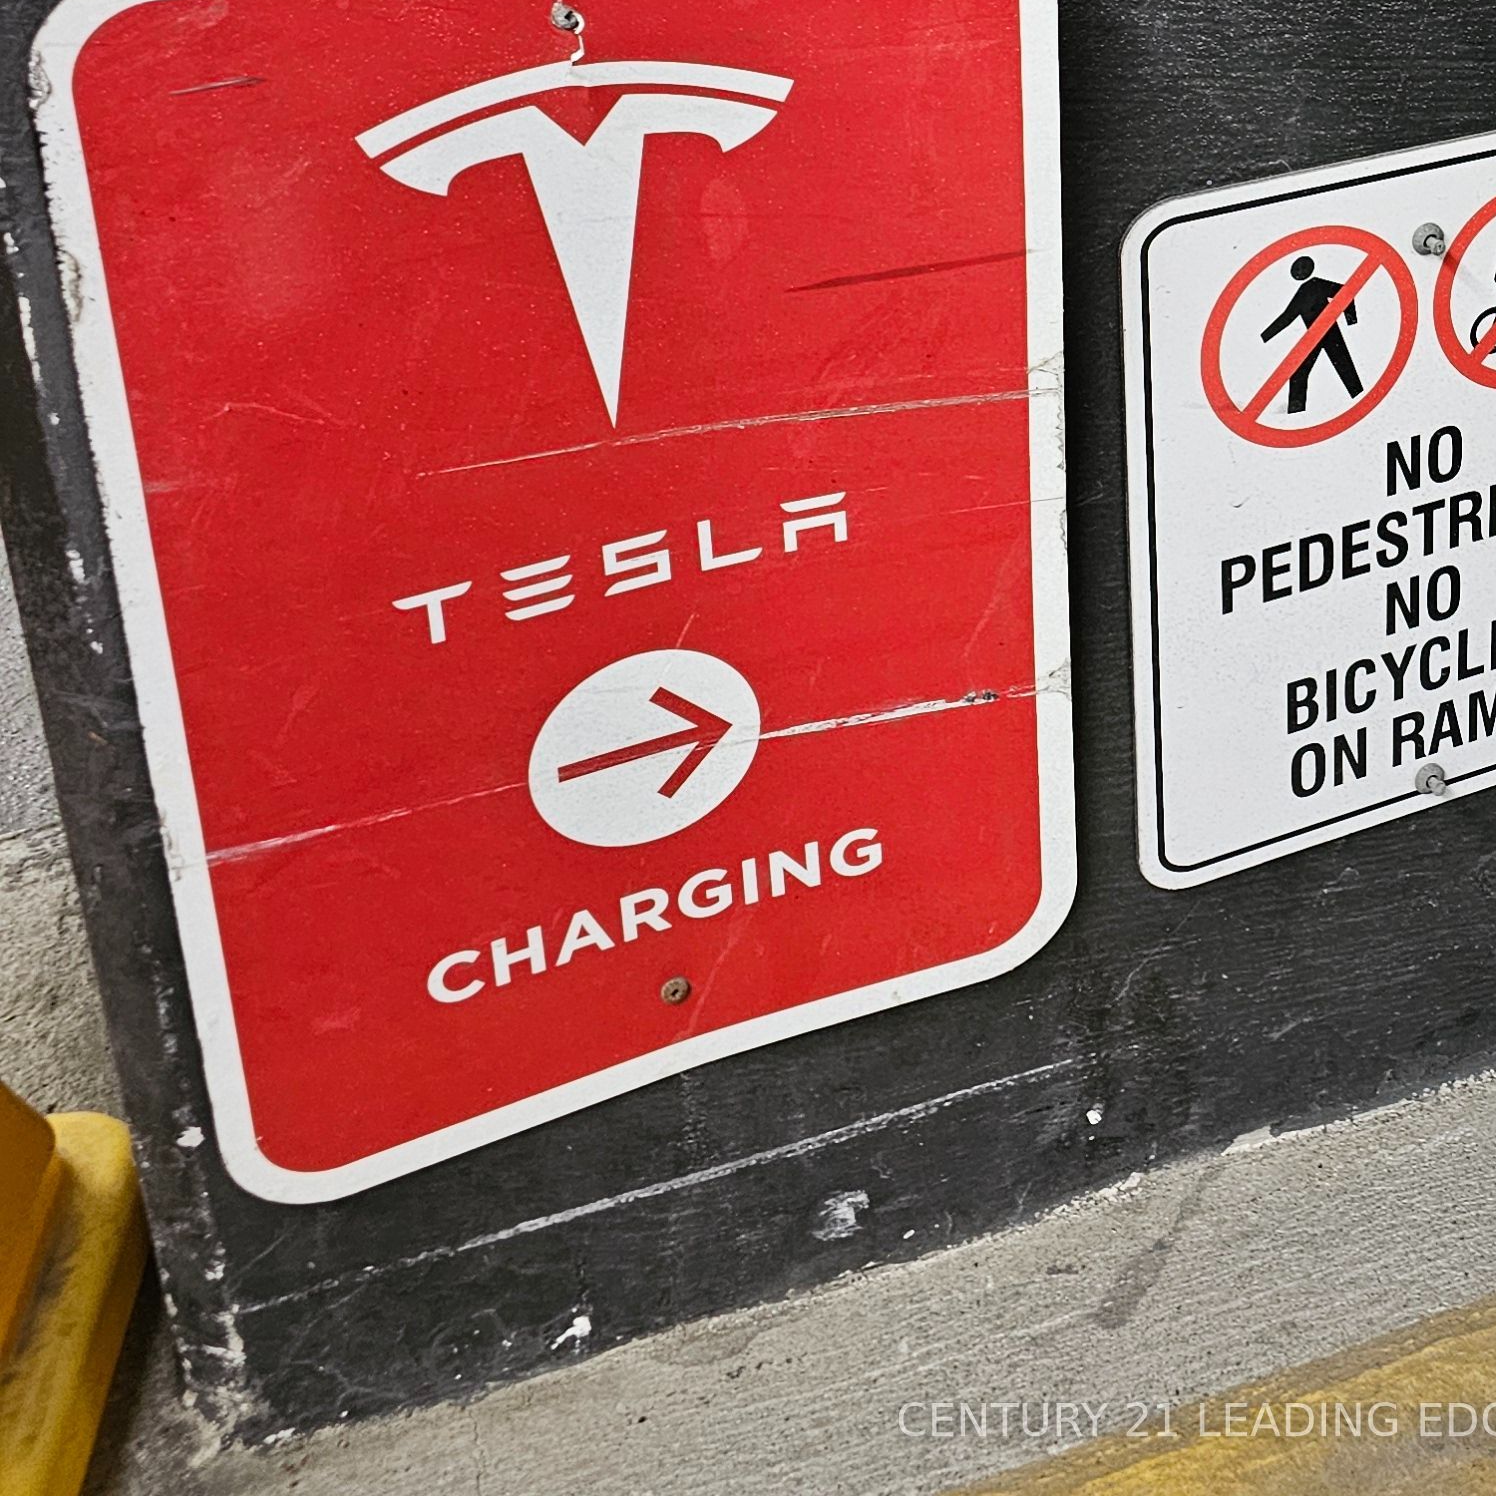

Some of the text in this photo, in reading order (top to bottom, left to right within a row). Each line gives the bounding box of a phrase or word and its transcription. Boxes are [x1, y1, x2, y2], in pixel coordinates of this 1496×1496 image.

[1386, 425, 1463, 496] NO
[391, 491, 848, 644] TESLA
[1385, 565, 1461, 636] NO
[1291, 727, 1367, 798] ON
[426, 827, 883, 1004] CHARGING
